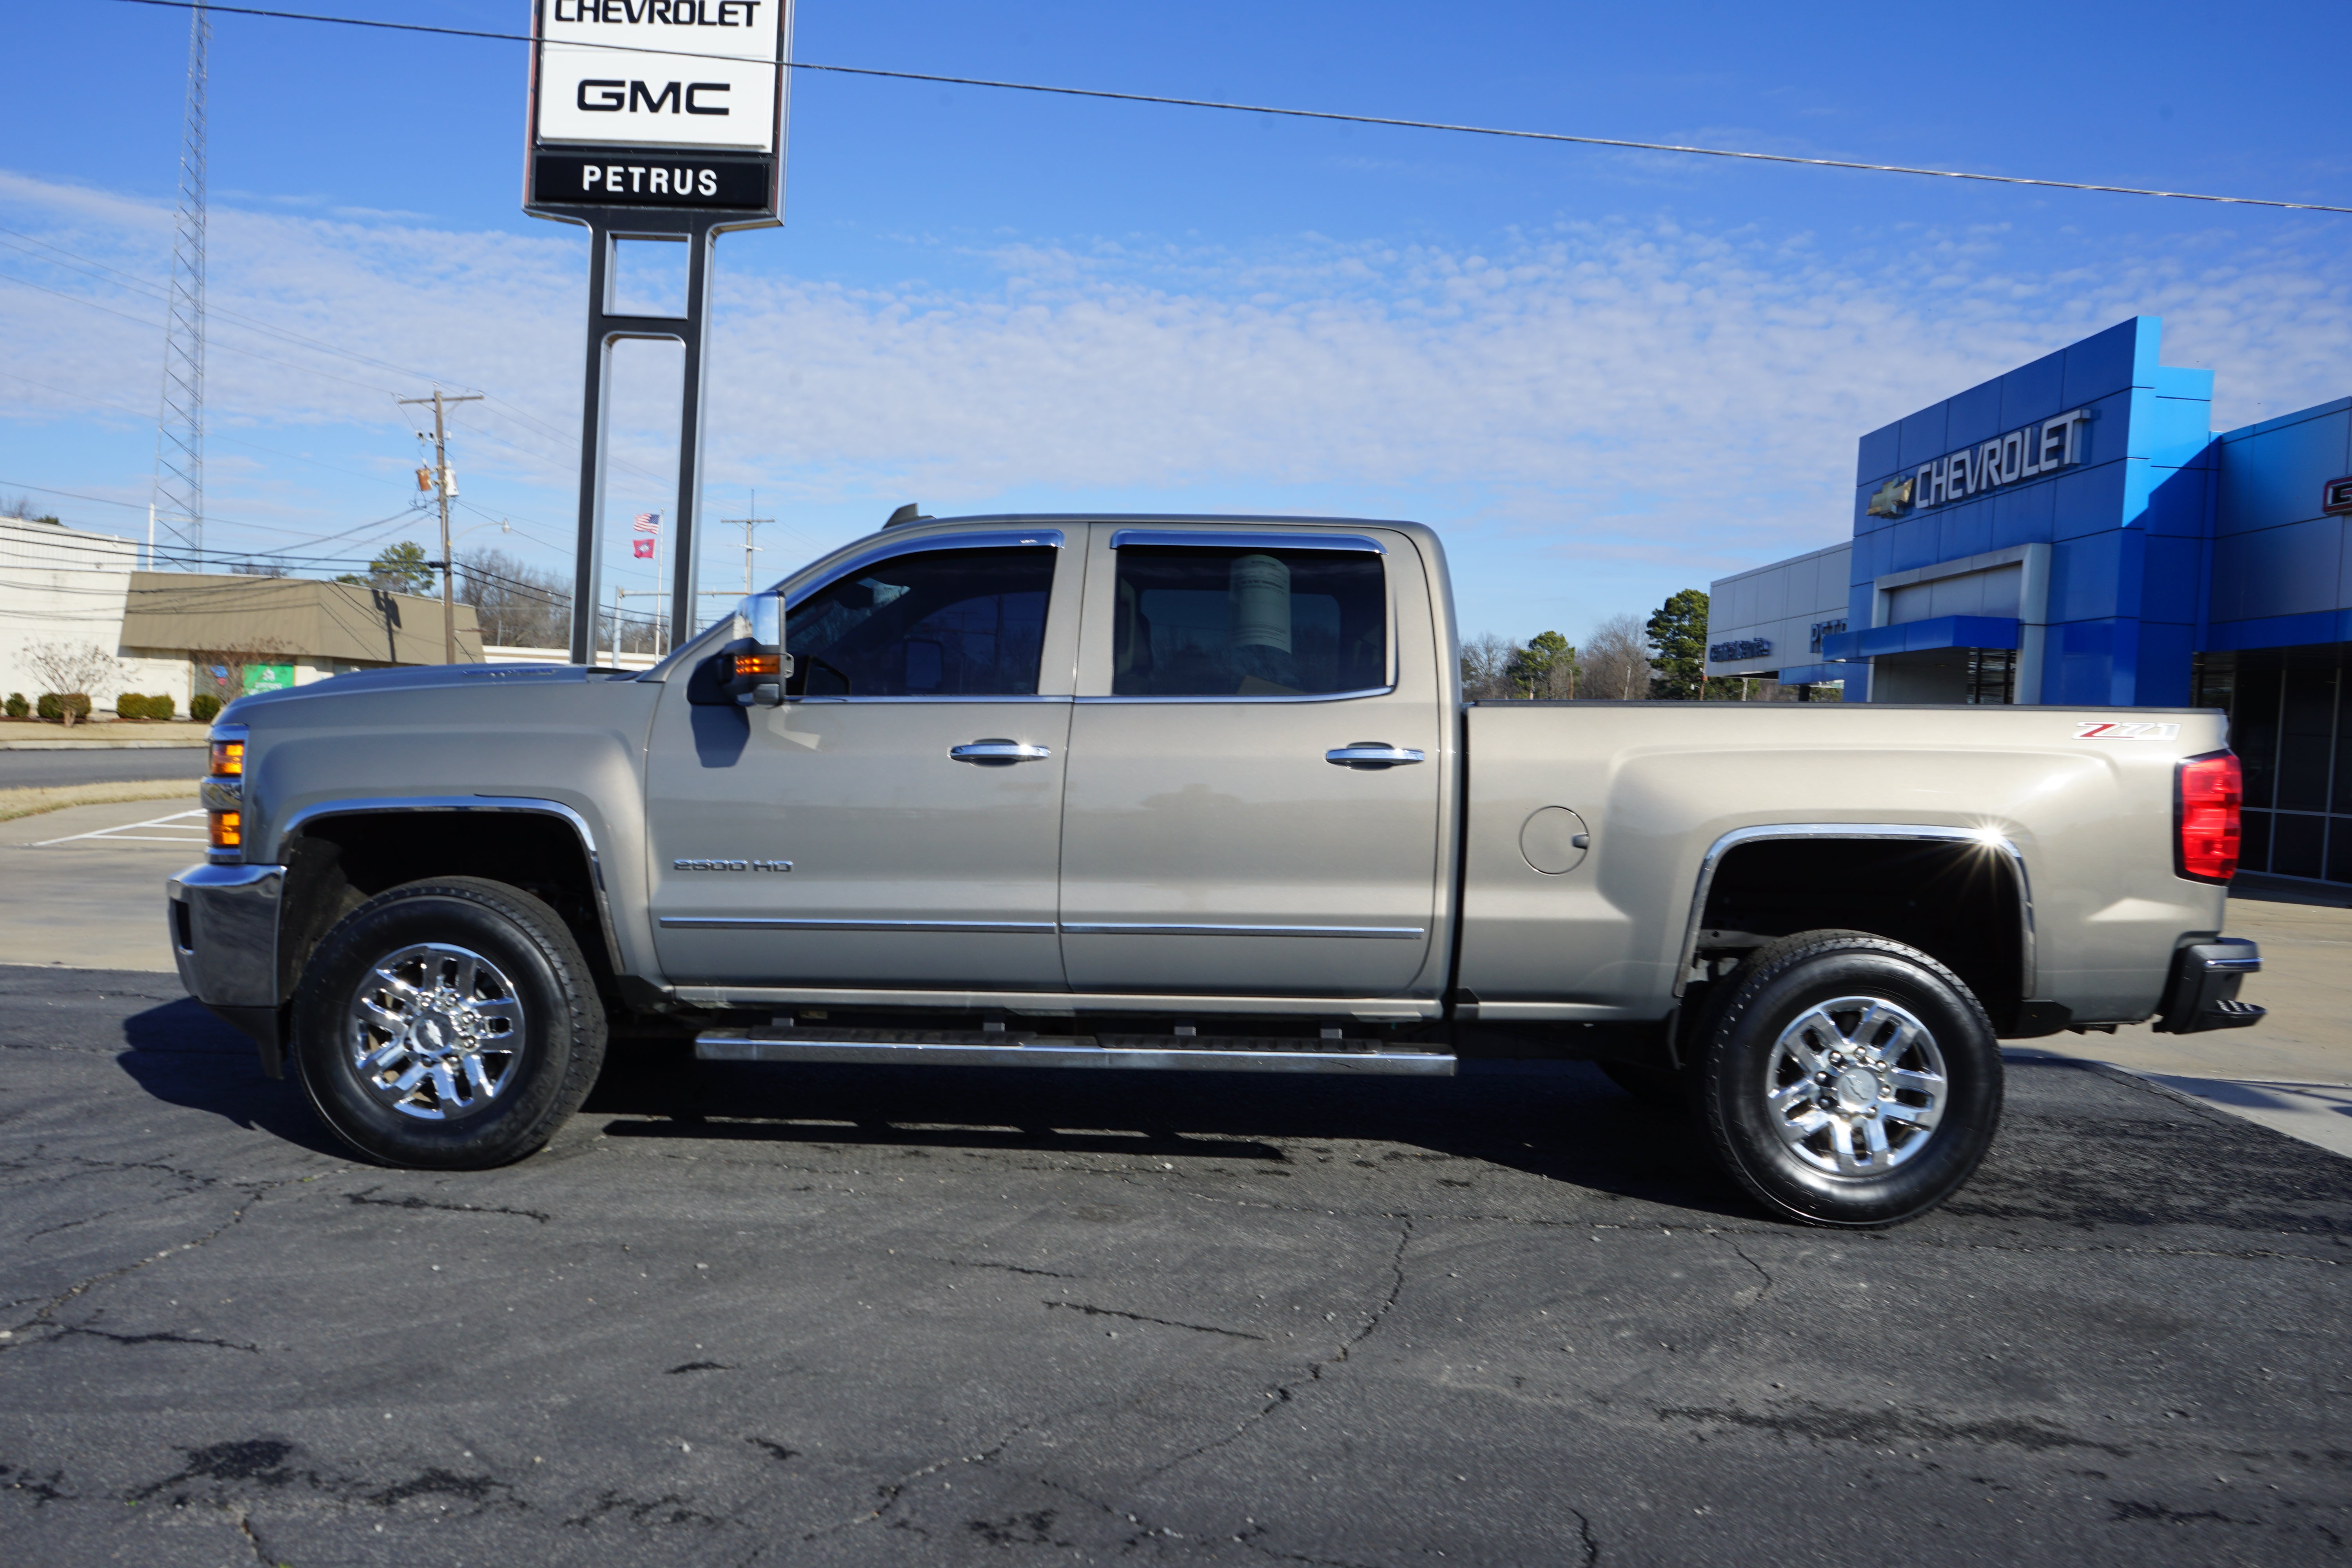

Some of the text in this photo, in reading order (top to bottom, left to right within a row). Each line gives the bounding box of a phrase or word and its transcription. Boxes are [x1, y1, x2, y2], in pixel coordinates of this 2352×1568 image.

[555, 0, 761, 27] CHEVROLET
[577, 79, 731, 115] GMC
[583, 165, 718, 196] PETRUS
[1915, 409, 2091, 509] CHEVROLET
[2072, 722, 2182, 741] Z71
[674, 859, 793, 872] 2500 HD
